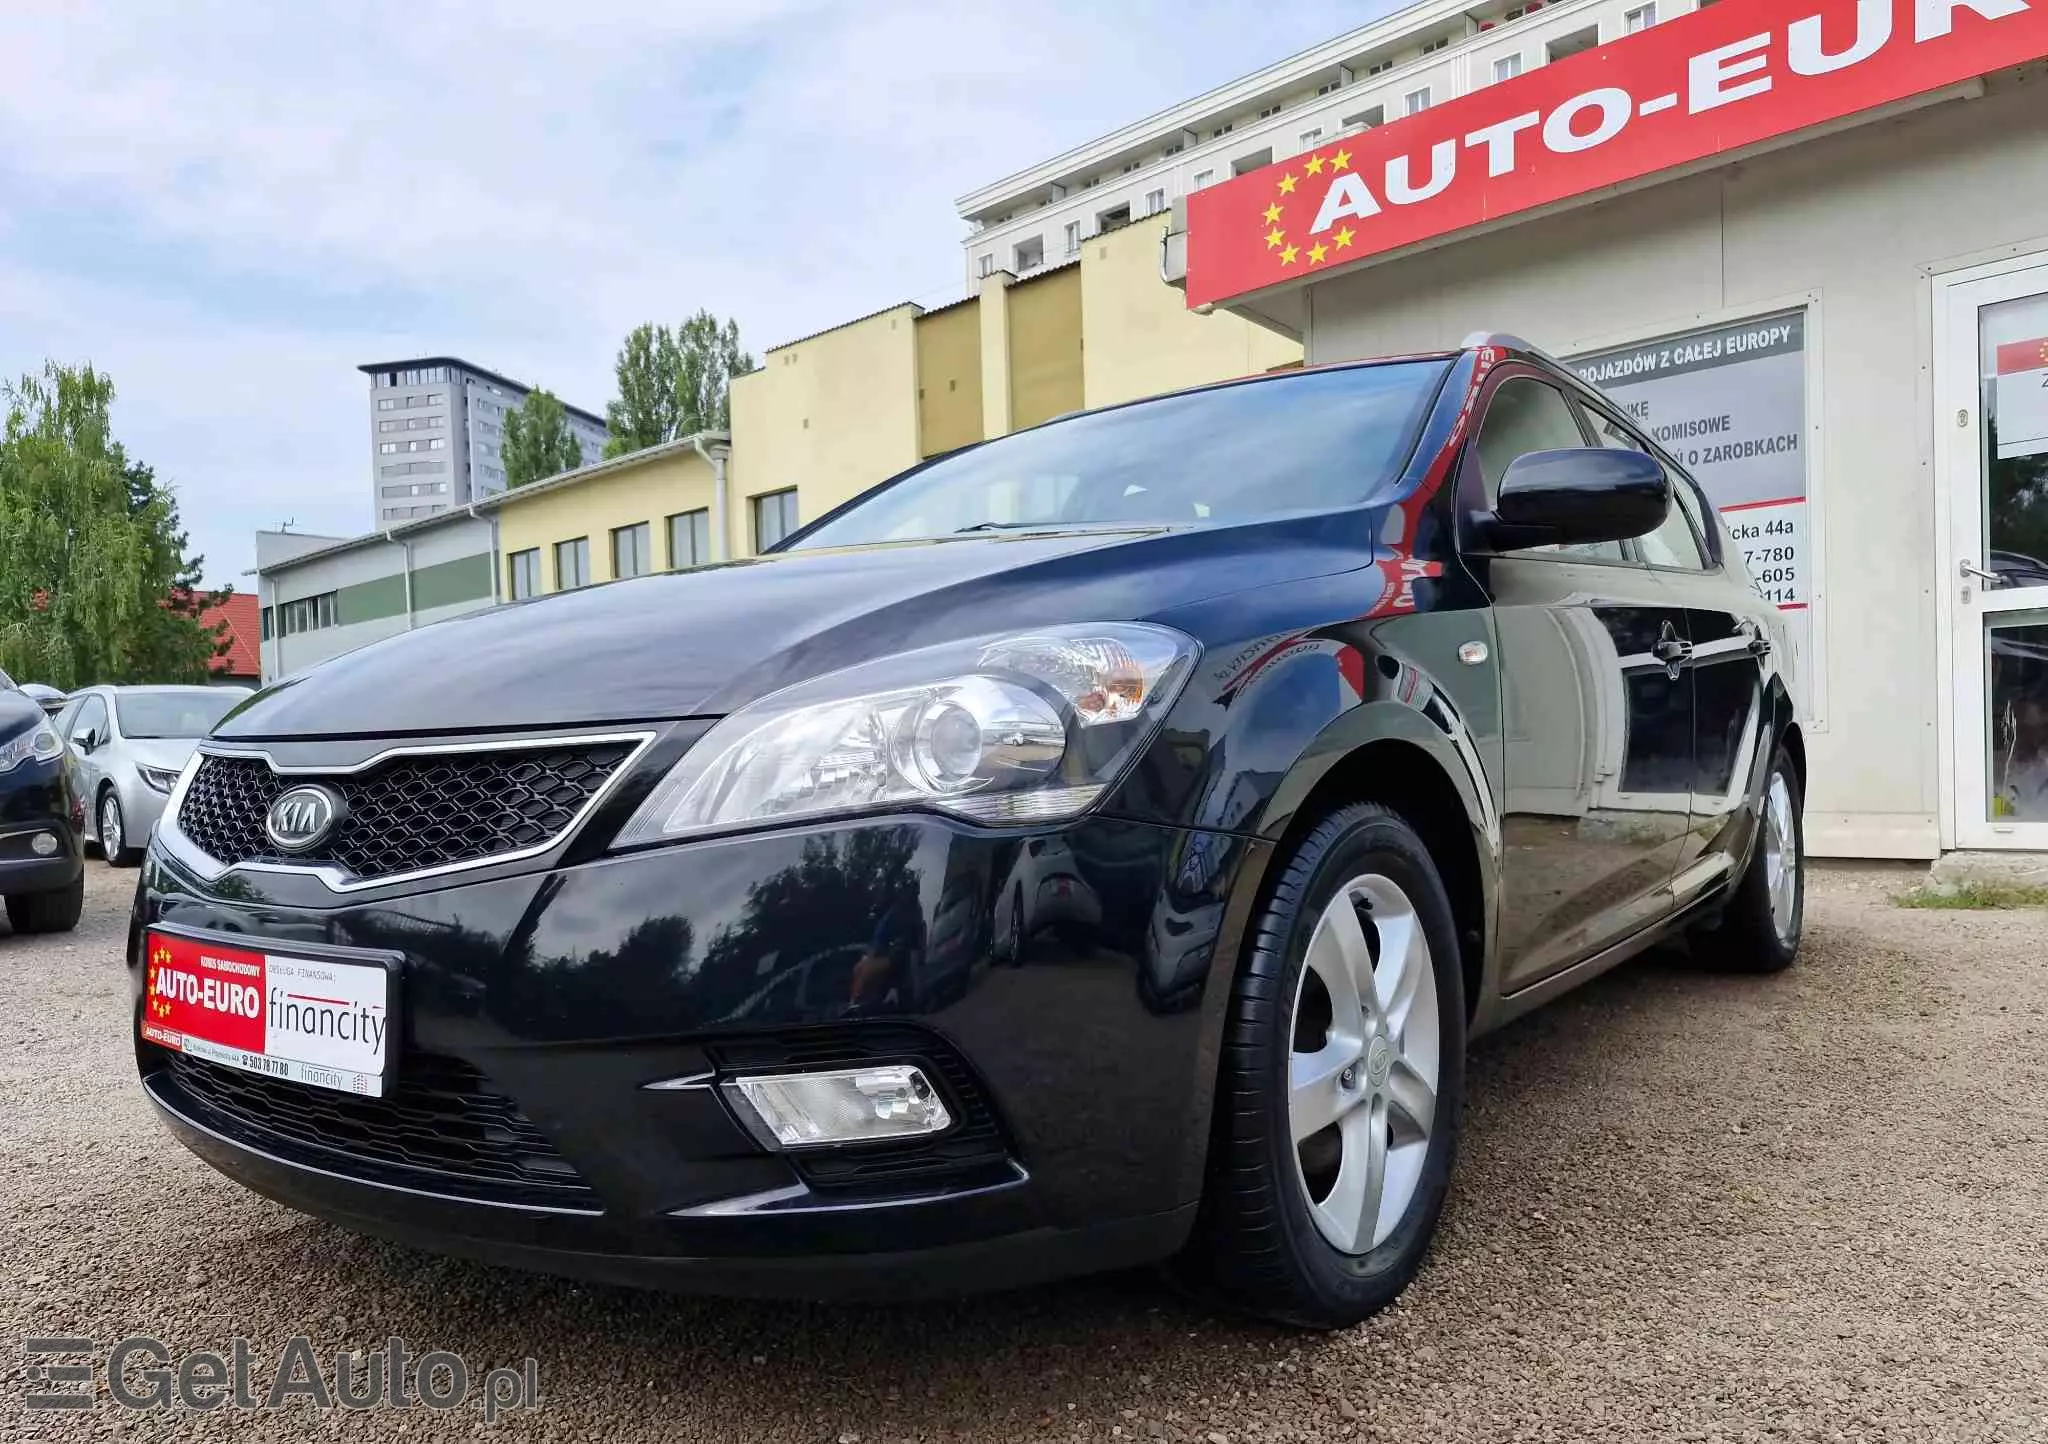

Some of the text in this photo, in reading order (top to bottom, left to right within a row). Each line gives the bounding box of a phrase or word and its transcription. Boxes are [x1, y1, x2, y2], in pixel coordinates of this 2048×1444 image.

[1659, 349, 1671, 369] Z
[1673, 338, 1722, 365] CAŁEJ
[1726, 325, 1791, 355] EUROPY
[1651, 415, 1731, 442] KOMISOWE
[1688, 450, 1699, 467] O
[1702, 433, 1799, 466] ZAROBKACH
[1764, 519, 1795, 536] 44a
[1744, 545, 1795, 565] 7-780
[275, 801, 318, 833] KIA
[155, 966, 260, 1019] AUTO-EURO
[268, 987, 387, 1056] financity
[145, 1025, 181, 1047] AUTO-EURO
[249, 1055, 289, 1076] 503 78 77 80
[300, 1063, 343, 1089] financity
